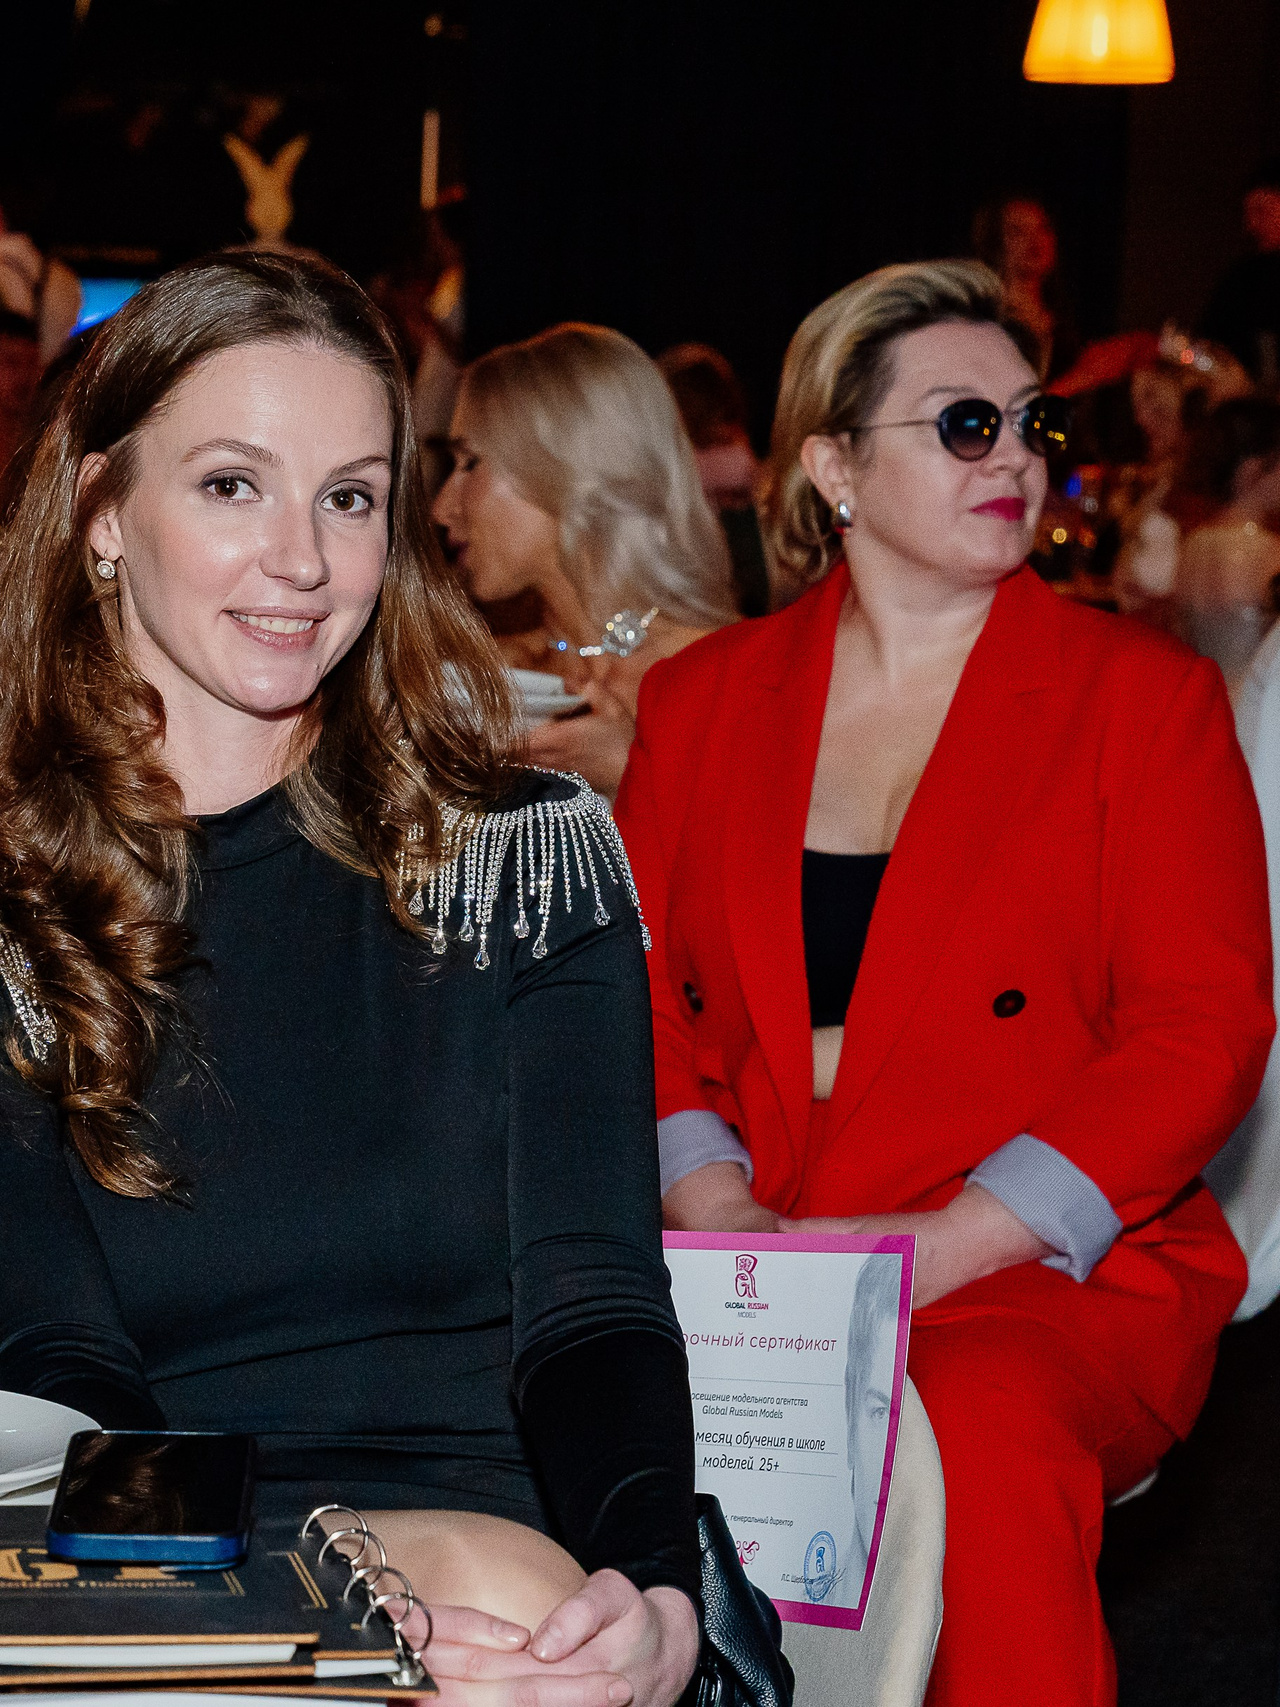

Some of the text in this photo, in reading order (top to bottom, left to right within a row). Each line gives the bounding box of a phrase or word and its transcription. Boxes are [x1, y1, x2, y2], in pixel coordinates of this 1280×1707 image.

[724, 1301, 769, 1310] GLOBAL RUSSIAN
[737, 1311, 757, 1319] MODELS
[749, 1335, 837, 1353] сертификат
[731, 1392, 775, 1406] модельного
[775, 1398, 809, 1407] агентства
[702, 1404, 784, 1419] Global Russian Models
[695, 1431, 826, 1451] месяц обучения в школе
[702, 1453, 780, 1472] моделей 25+
